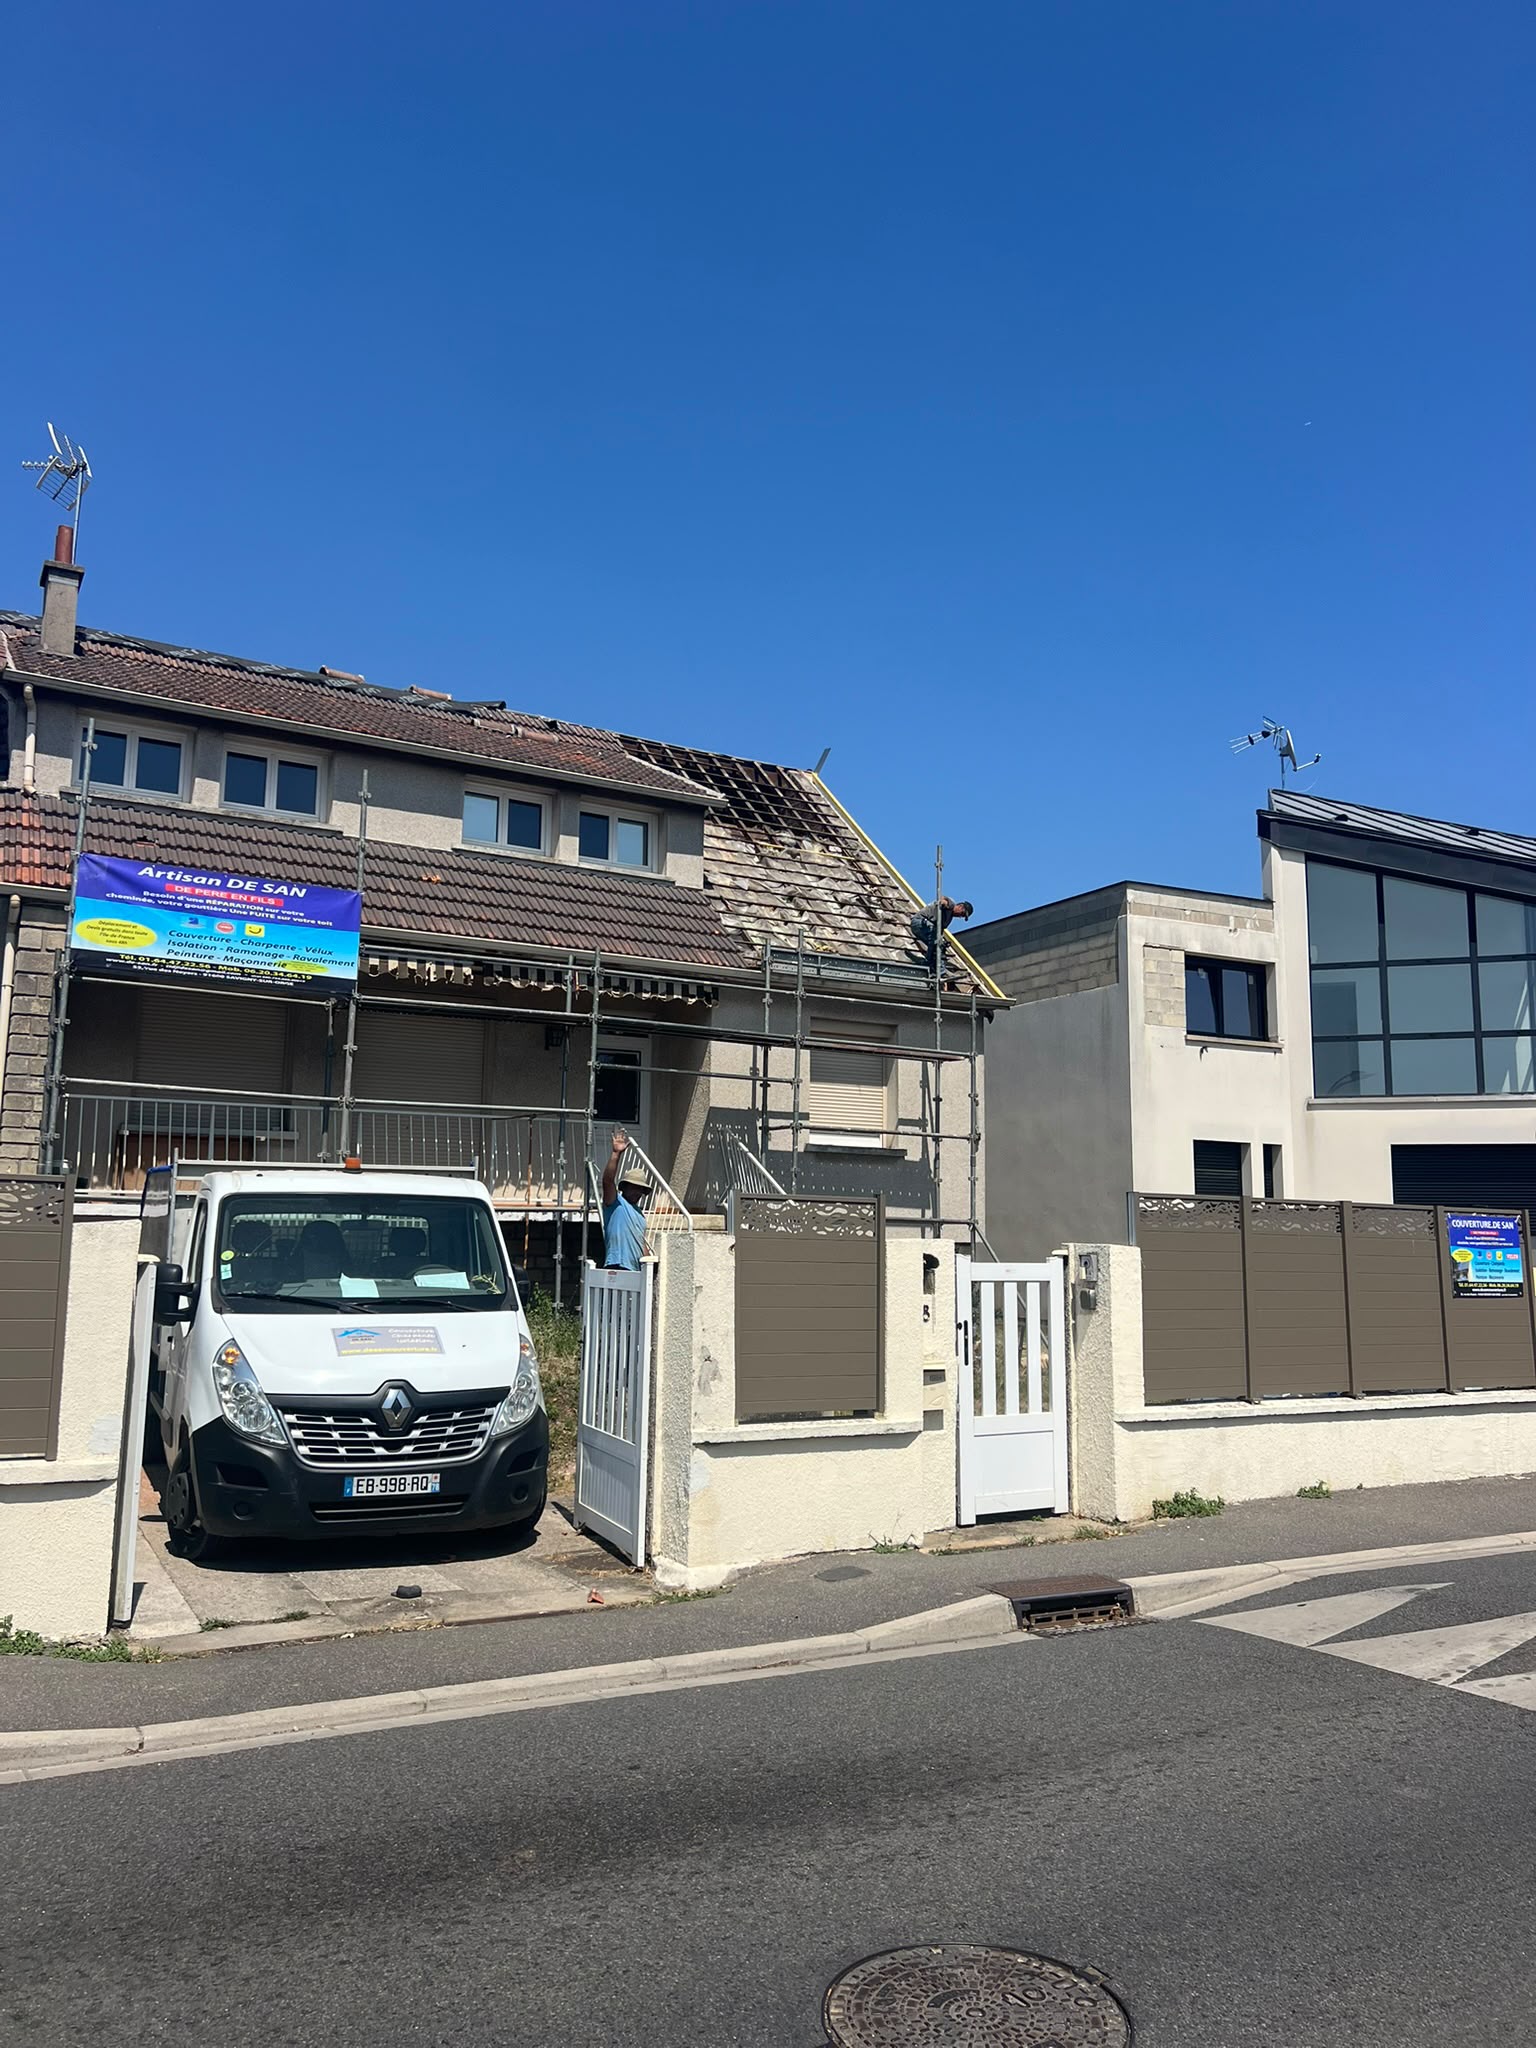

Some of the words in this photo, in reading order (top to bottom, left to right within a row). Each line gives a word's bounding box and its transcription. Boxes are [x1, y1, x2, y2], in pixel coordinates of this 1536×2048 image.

[137, 866, 221, 886] Artisan
[226, 878, 258, 891] DE
[260, 882, 306, 897] SAN
[105, 892, 155, 903] cheminée,
[184, 902, 227, 912] gouttière
[143, 890, 175, 899] Besoin
[176, 895, 204, 903] d'une
[174, 885, 192, 893] DE
[195, 888, 226, 898] PERE
[231, 893, 246, 901] EN
[250, 896, 274, 904] FILS
[168, 929, 231, 943] Couverture
[240, 938, 296, 952] Charpente
[305, 946, 334, 955] Vélux
[166, 948, 214, 960] Peinture
[222, 955, 287, 969] Maçonnerie
[167, 939, 216, 950] Isolation
[225, 946, 284, 959] Ramonage
[292, 953, 354, 967] Ravalement
[1502, 1221, 1514, 1230] SAN
[356, 1476, 429, 1494] EB-998-RQ
